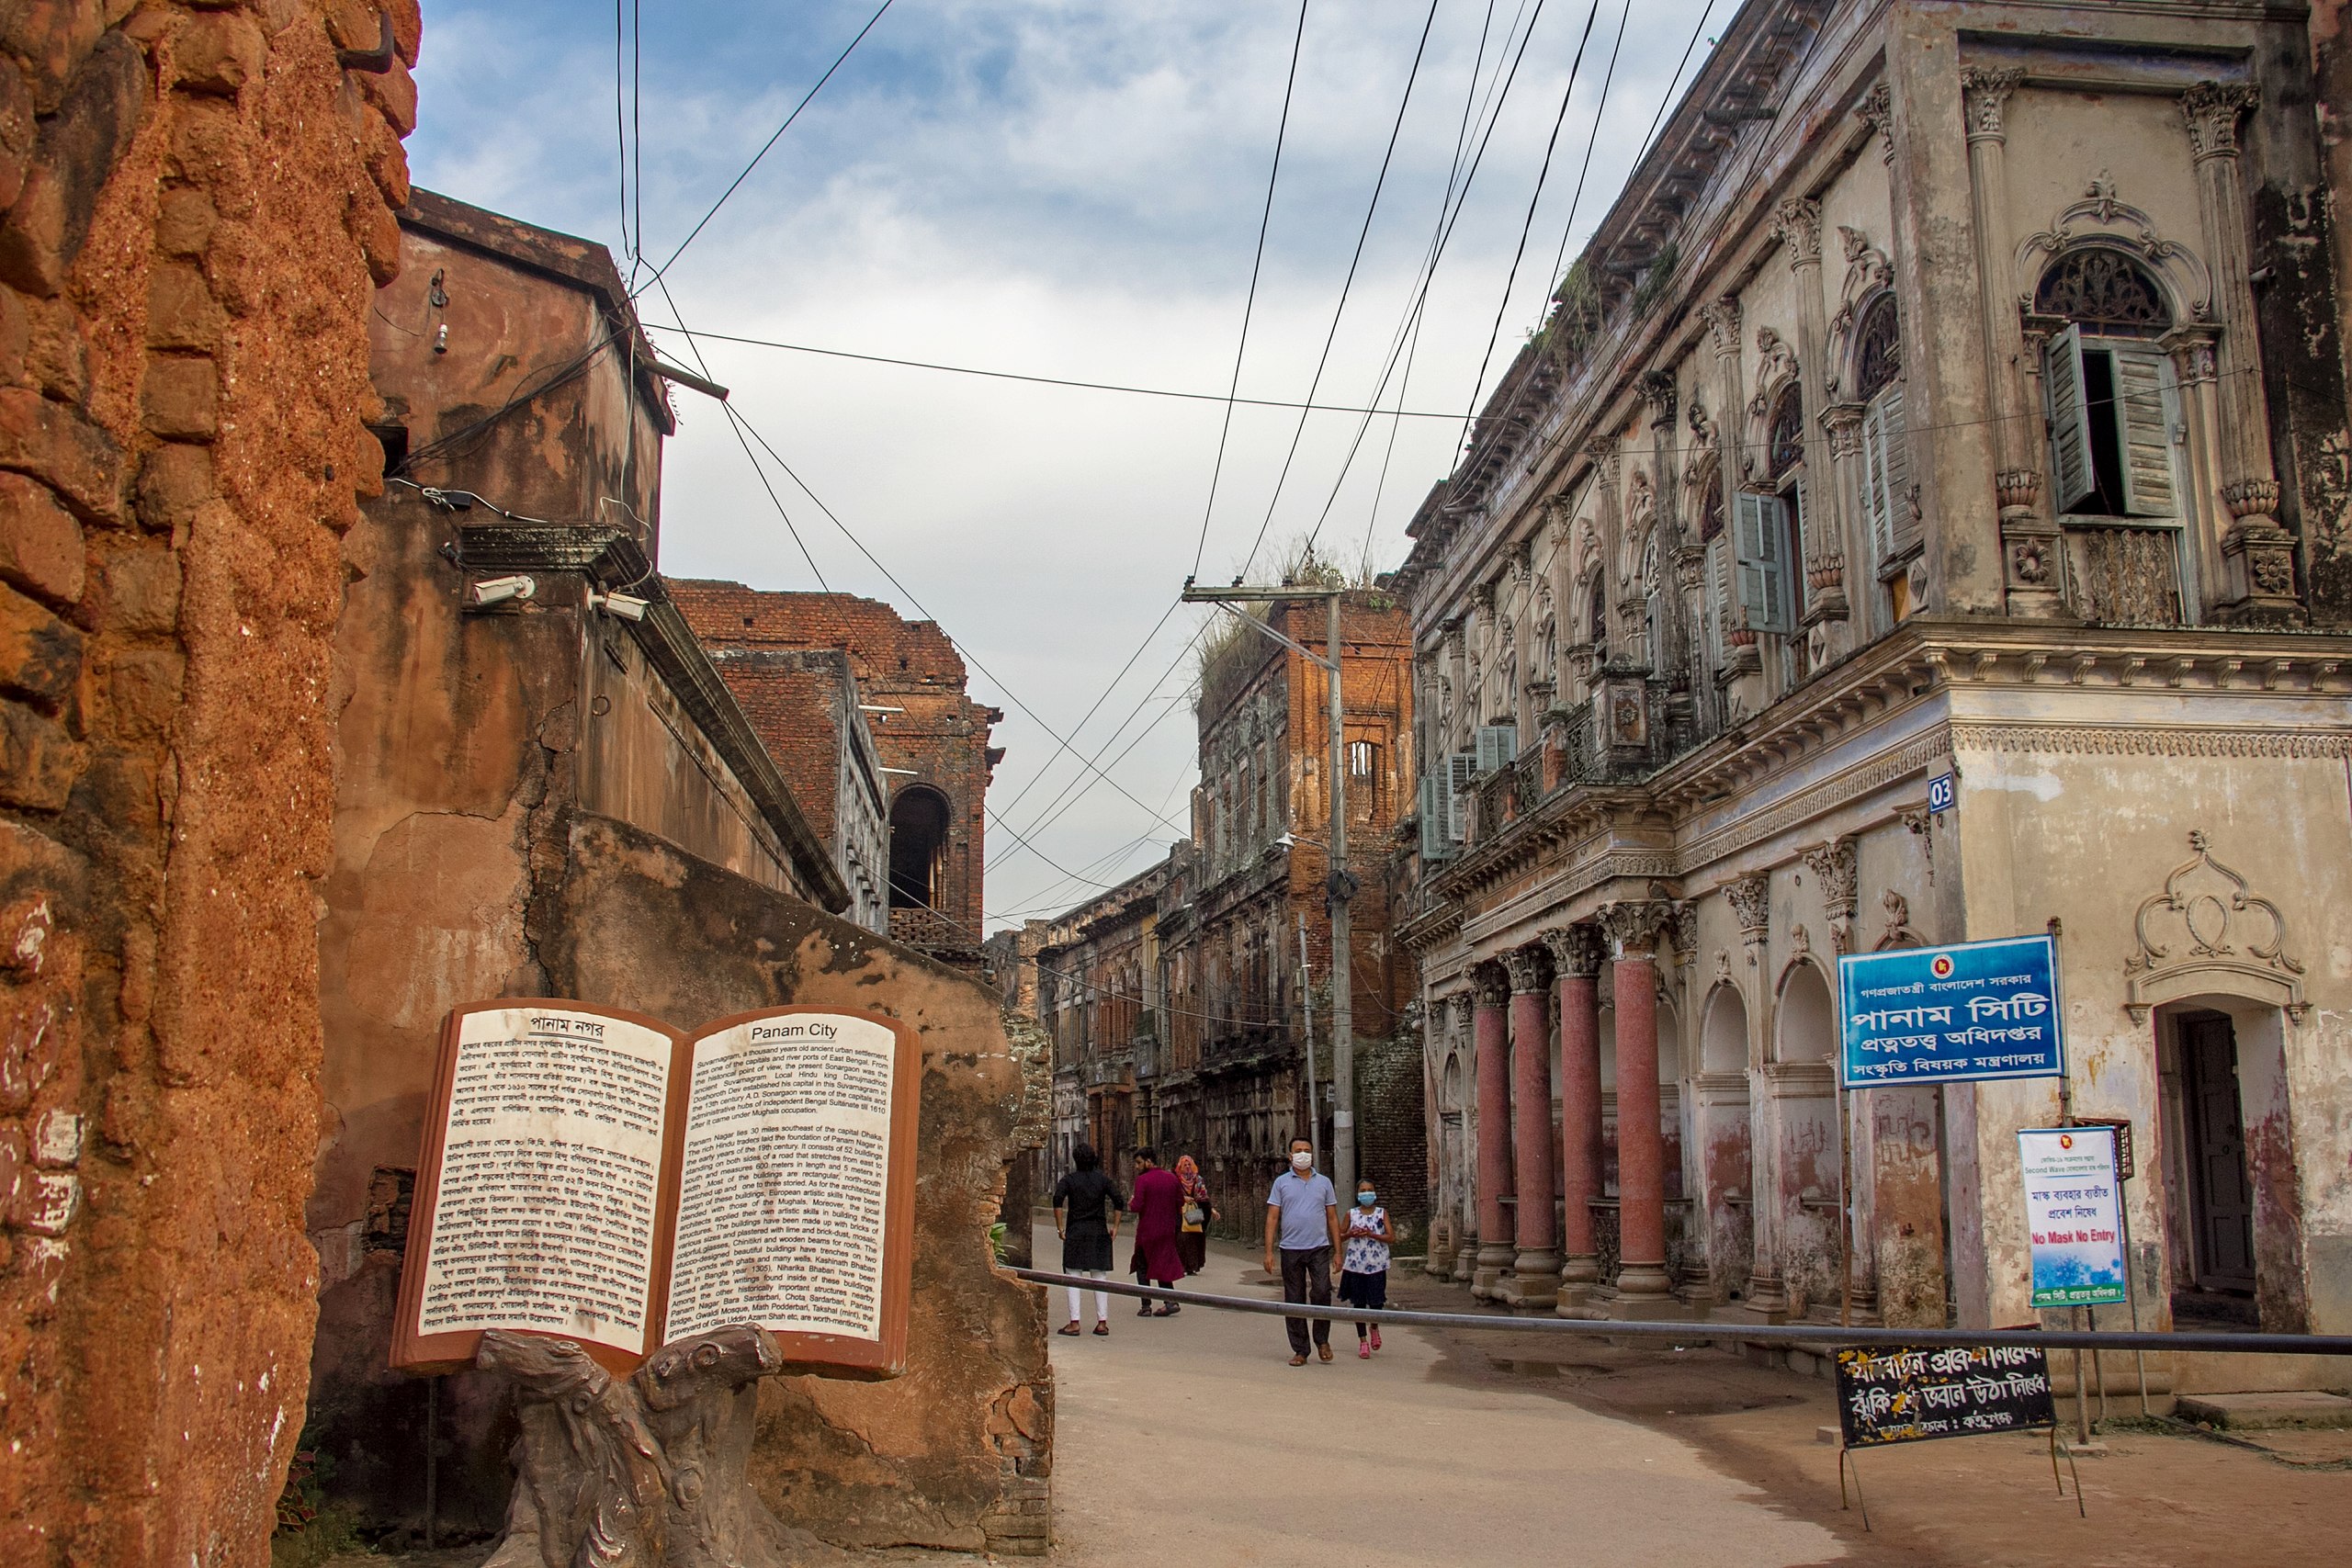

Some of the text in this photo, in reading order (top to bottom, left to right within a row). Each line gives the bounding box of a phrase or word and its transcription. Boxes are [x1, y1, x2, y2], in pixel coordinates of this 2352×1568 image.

[1931, 779, 1951, 806] 03
[1860, 975, 2031, 998] গণপ্রজাতন্ত্রী বাংলাদেশ সরকার
[1850, 993, 2050, 1032] পানাম সিটি
[530, 1016, 605, 1037] পানাম নগর
[751, 1023, 838, 1040] Panam City
[748, 1045, 778, 1055] thousand
[778, 1045, 797, 1054] years
[834, 1046, 853, 1055] urban
[1860, 1025, 2042, 1054] প্রত্নতত্ত্ব অধিদপ্তর
[695, 1068, 709, 1077] was
[710, 1065, 723, 1073] one
[724, 1061, 732, 1069] of
[744, 1055, 770, 1066] capitals
[771, 1054, 785, 1062] and
[829, 1054, 843, 1062] East
[871, 1059, 888, 1069] From
[707, 1068, 737, 1082] historical
[738, 1066, 754, 1077] point
[756, 1064, 764, 1072] of
[824, 1062, 860, 1073] Sonargaon
[876, 1070, 888, 1078] the
[1853, 1053, 2044, 1078] সংস্কৃতি বিষয়ক মন্ত্রণালয়
[692, 1104, 703, 1112] the
[705, 1100, 718, 1108] 13th
[719, 1095, 744, 1104] century
[761, 1089, 797, 1098] Sonargaon
[847, 1092, 872, 1102] capitals
[687, 1136, 711, 1148] Panam
[713, 1132, 734, 1141] Nagar
[750, 1126, 759, 1134] 30
[837, 1128, 859, 1136] capital
[701, 1145, 714, 1153] rich
[715, 1140, 735, 1150] Hindu
[736, 1136, 760, 1145] traders
[786, 1133, 821, 1141] foundation
[831, 1134, 854, 1145] Panam
[855, 1138, 876, 1149] Nagar
[685, 1158, 697, 1167] the
[697, 1153, 715, 1163] early
[716, 1149, 735, 1160] years
[736, 1145, 744, 1154] of
[758, 1142, 772, 1151] 19th
[843, 1145, 853, 1154] 52
[854, 1147, 882, 1160] buildings
[2031, 1186, 2109, 1201] মাস্ক ব্যবহার ব্যতীত
[2048, 1205, 2097, 1219] প্রবেশ নিষেধ
[2031, 1229, 2115, 1245] No Mask No Entry
[670, 1305, 695, 1317] Panam
[697, 1300, 720, 1310] Nagar
[722, 1296, 740, 1304] Bara
[785, 1292, 806, 1302] Chota
[849, 1300, 873, 1312] Panam
